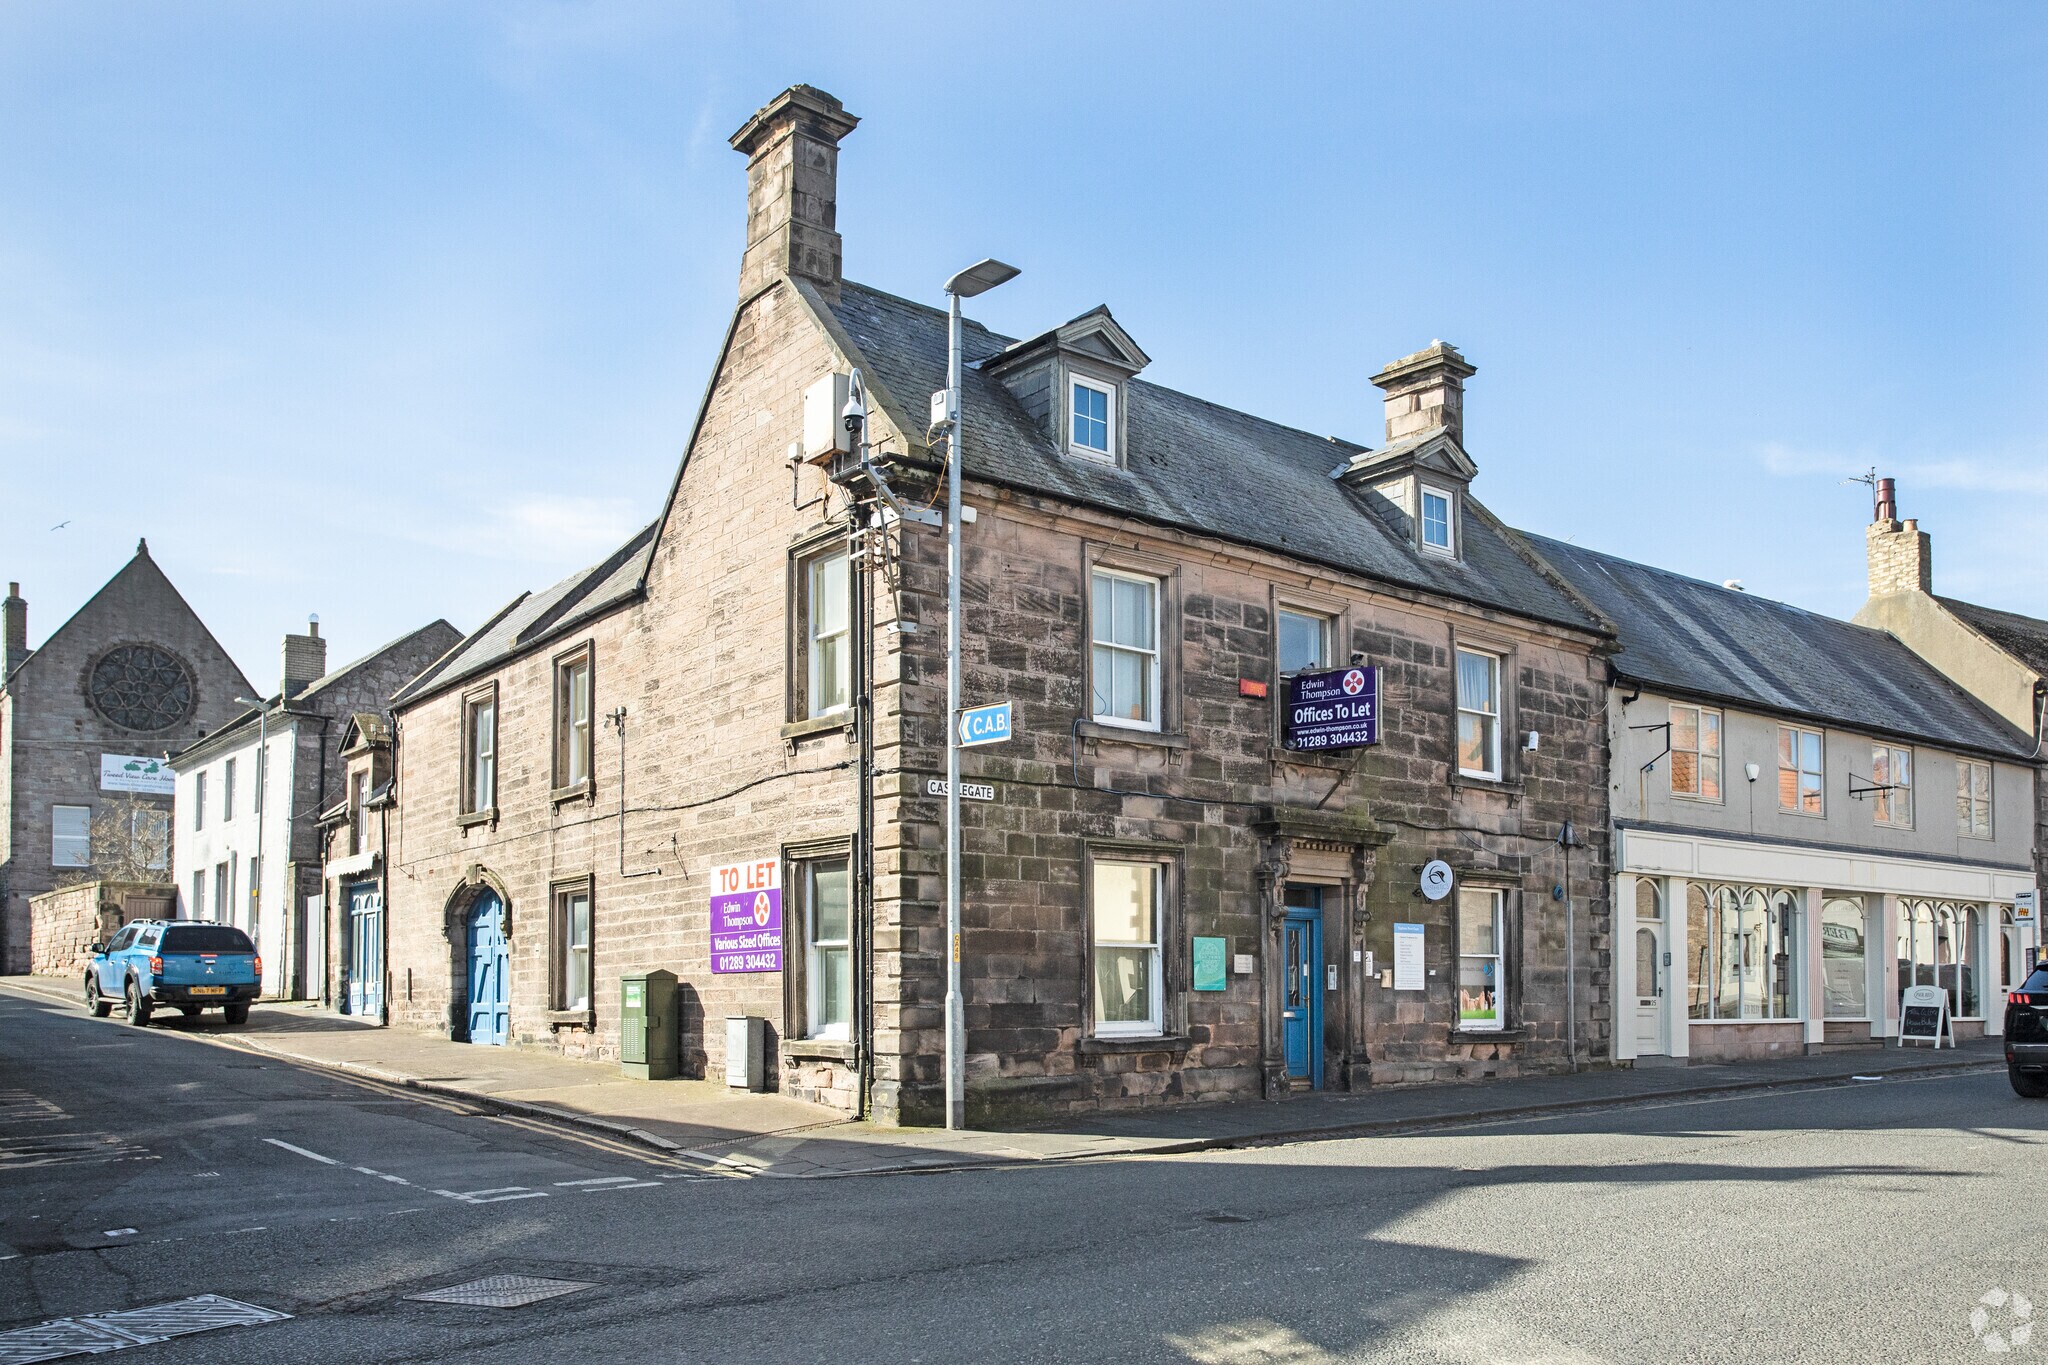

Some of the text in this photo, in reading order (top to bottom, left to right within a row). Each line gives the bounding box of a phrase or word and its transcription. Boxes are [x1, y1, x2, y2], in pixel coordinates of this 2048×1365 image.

[1301, 680, 1324, 690] Edwin
[1301, 687, 1340, 700] Thompson
[1294, 702, 1371, 724] Offices To Let
[973, 713, 1008, 735] C.A.B.
[1297, 722, 1368, 736] www.edwin-thompson.co.uk
[1330, 731, 1368, 745] 304432
[103, 770, 124, 778] Tweed
[142, 773, 157, 781] Care
[930, 782, 992, 798] CASEGATE
[719, 861, 776, 892] TO LET
[723, 901, 741, 914] Edwin
[723, 915, 753, 930] Thompson
[714, 932, 781, 950] Various Sized Offices
[719, 953, 776, 970] 01289 304432
